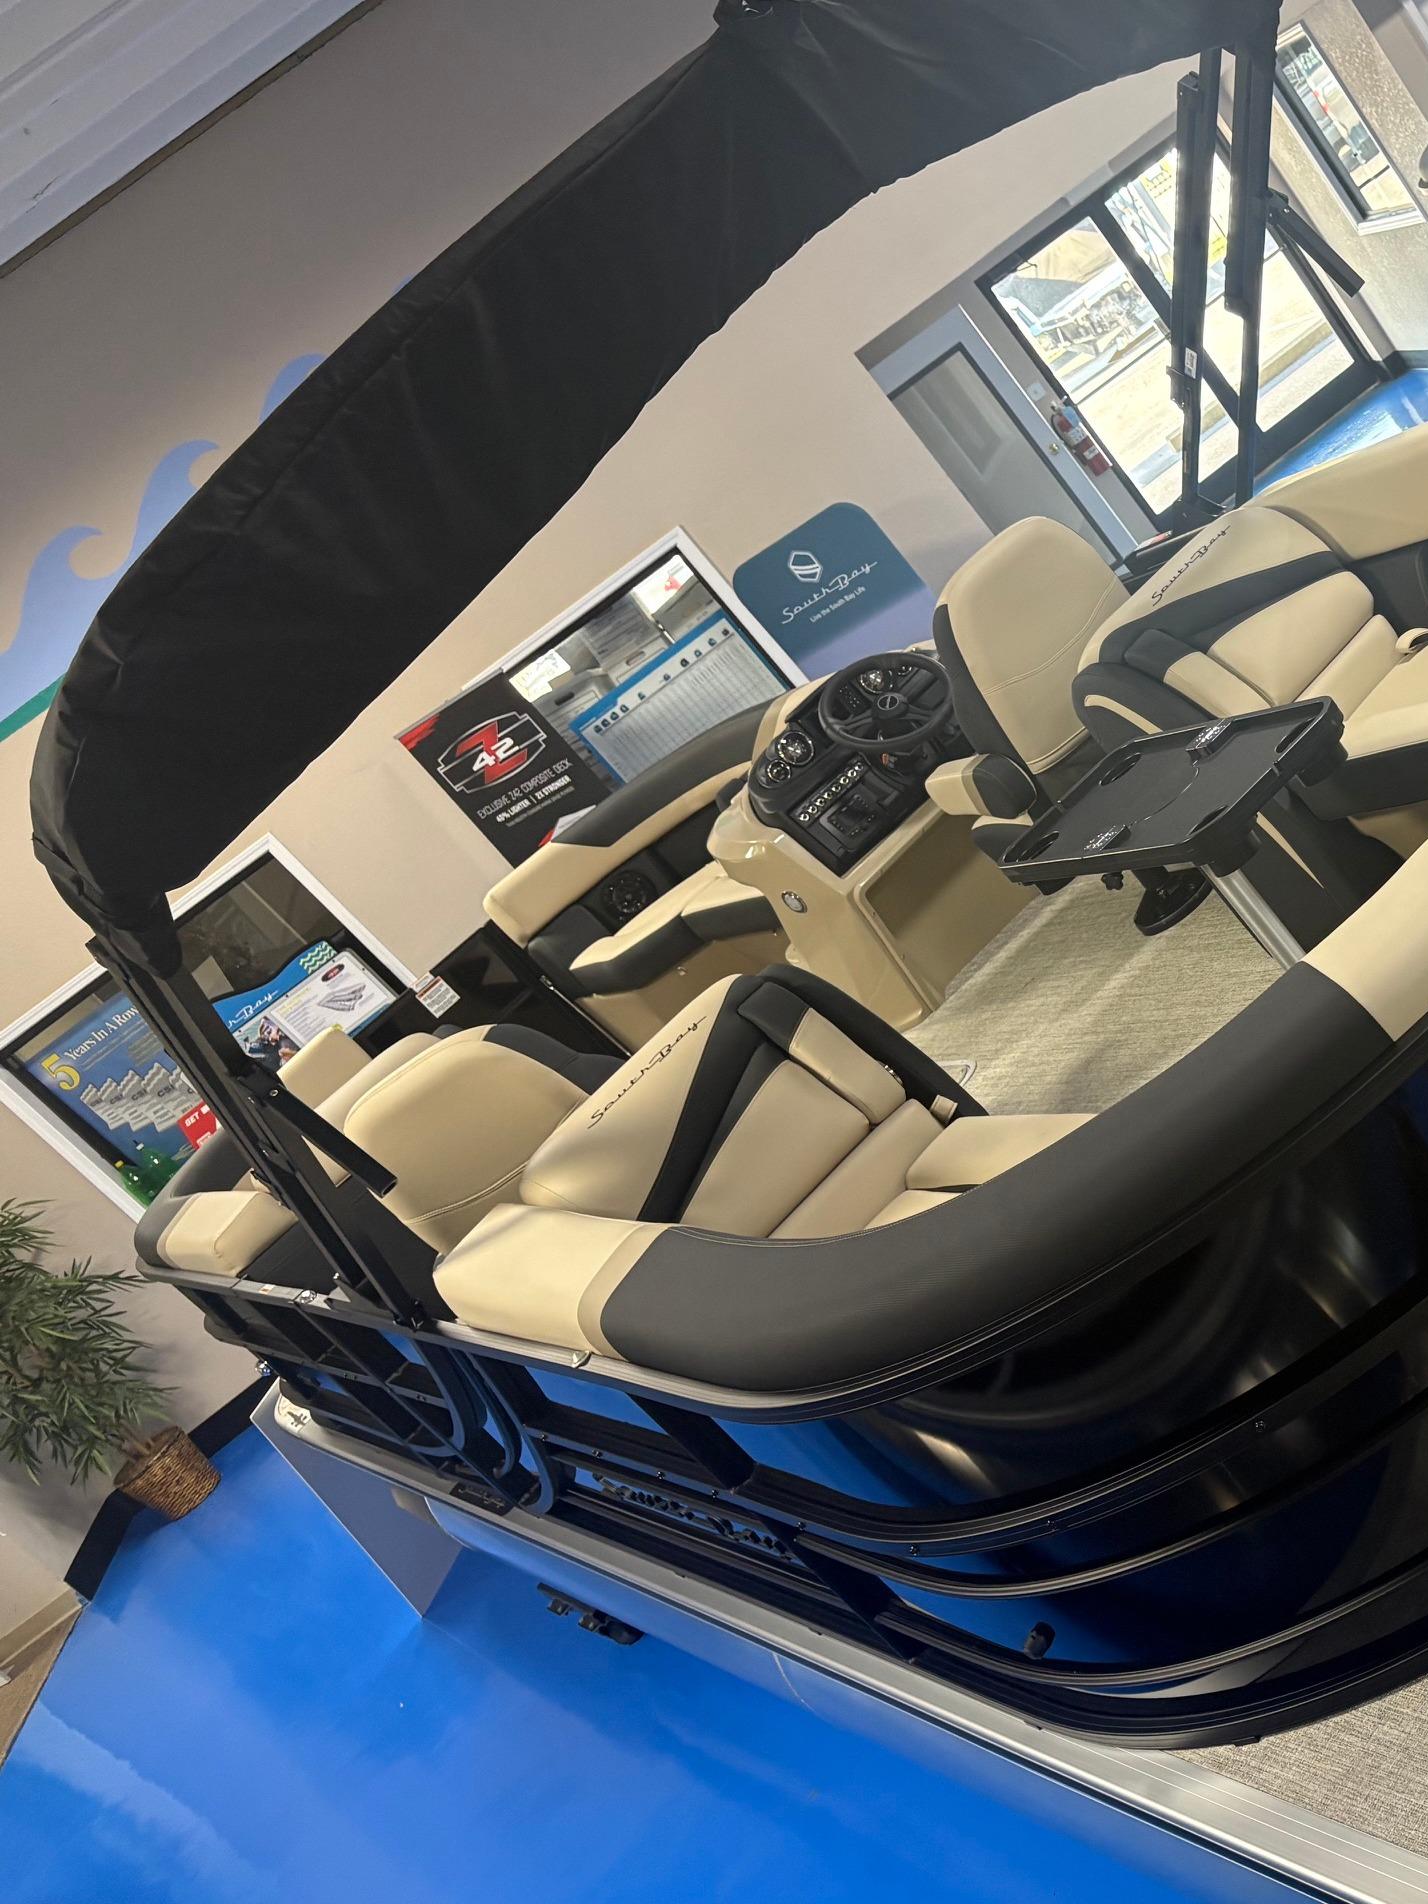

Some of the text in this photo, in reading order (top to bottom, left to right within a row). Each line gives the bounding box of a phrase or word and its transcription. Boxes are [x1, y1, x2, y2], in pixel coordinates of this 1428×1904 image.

[781, 561, 878, 625] South Bay
[1152, 524, 1231, 607] South Bay
[809, 613, 822, 623] Live
[829, 596, 847, 610] South
[845, 590, 857, 603] Bay
[855, 585, 866, 597] Life
[476, 794, 511, 820] EXCLUSIVE
[520, 768, 555, 793] COMPOSITE
[552, 757, 574, 774] DECK
[508, 798, 532, 815] LIGHTER
[542, 774, 572, 796] STRONGER
[41, 1004, 141, 1091] 5 Years In A Row
[587, 1015, 707, 1130] South Bay
